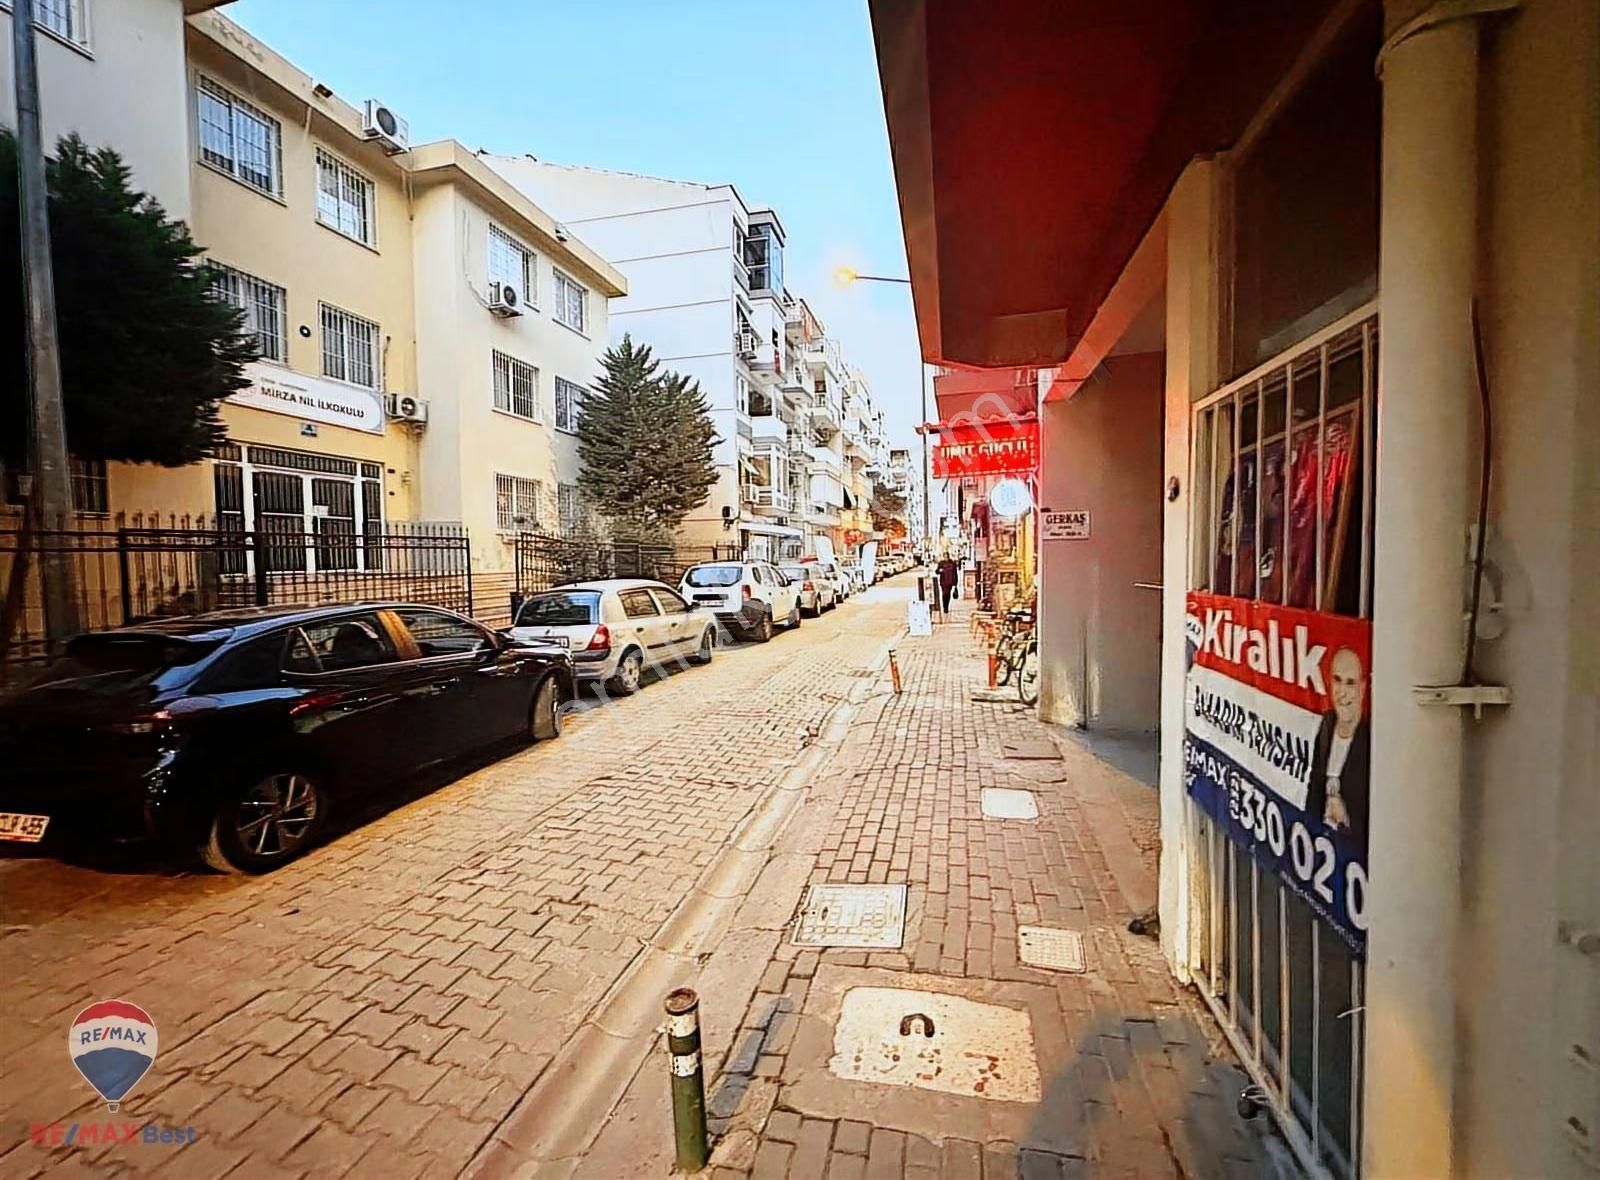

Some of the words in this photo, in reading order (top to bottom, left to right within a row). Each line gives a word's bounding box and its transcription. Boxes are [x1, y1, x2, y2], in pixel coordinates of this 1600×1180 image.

[1045, 512, 1086, 526] GERKAŞ
[1203, 607, 1328, 696] Kiralık
[1239, 777, 1285, 858] 330
[1291, 821, 1336, 904] 02
[1345, 861, 1369, 931] 0
